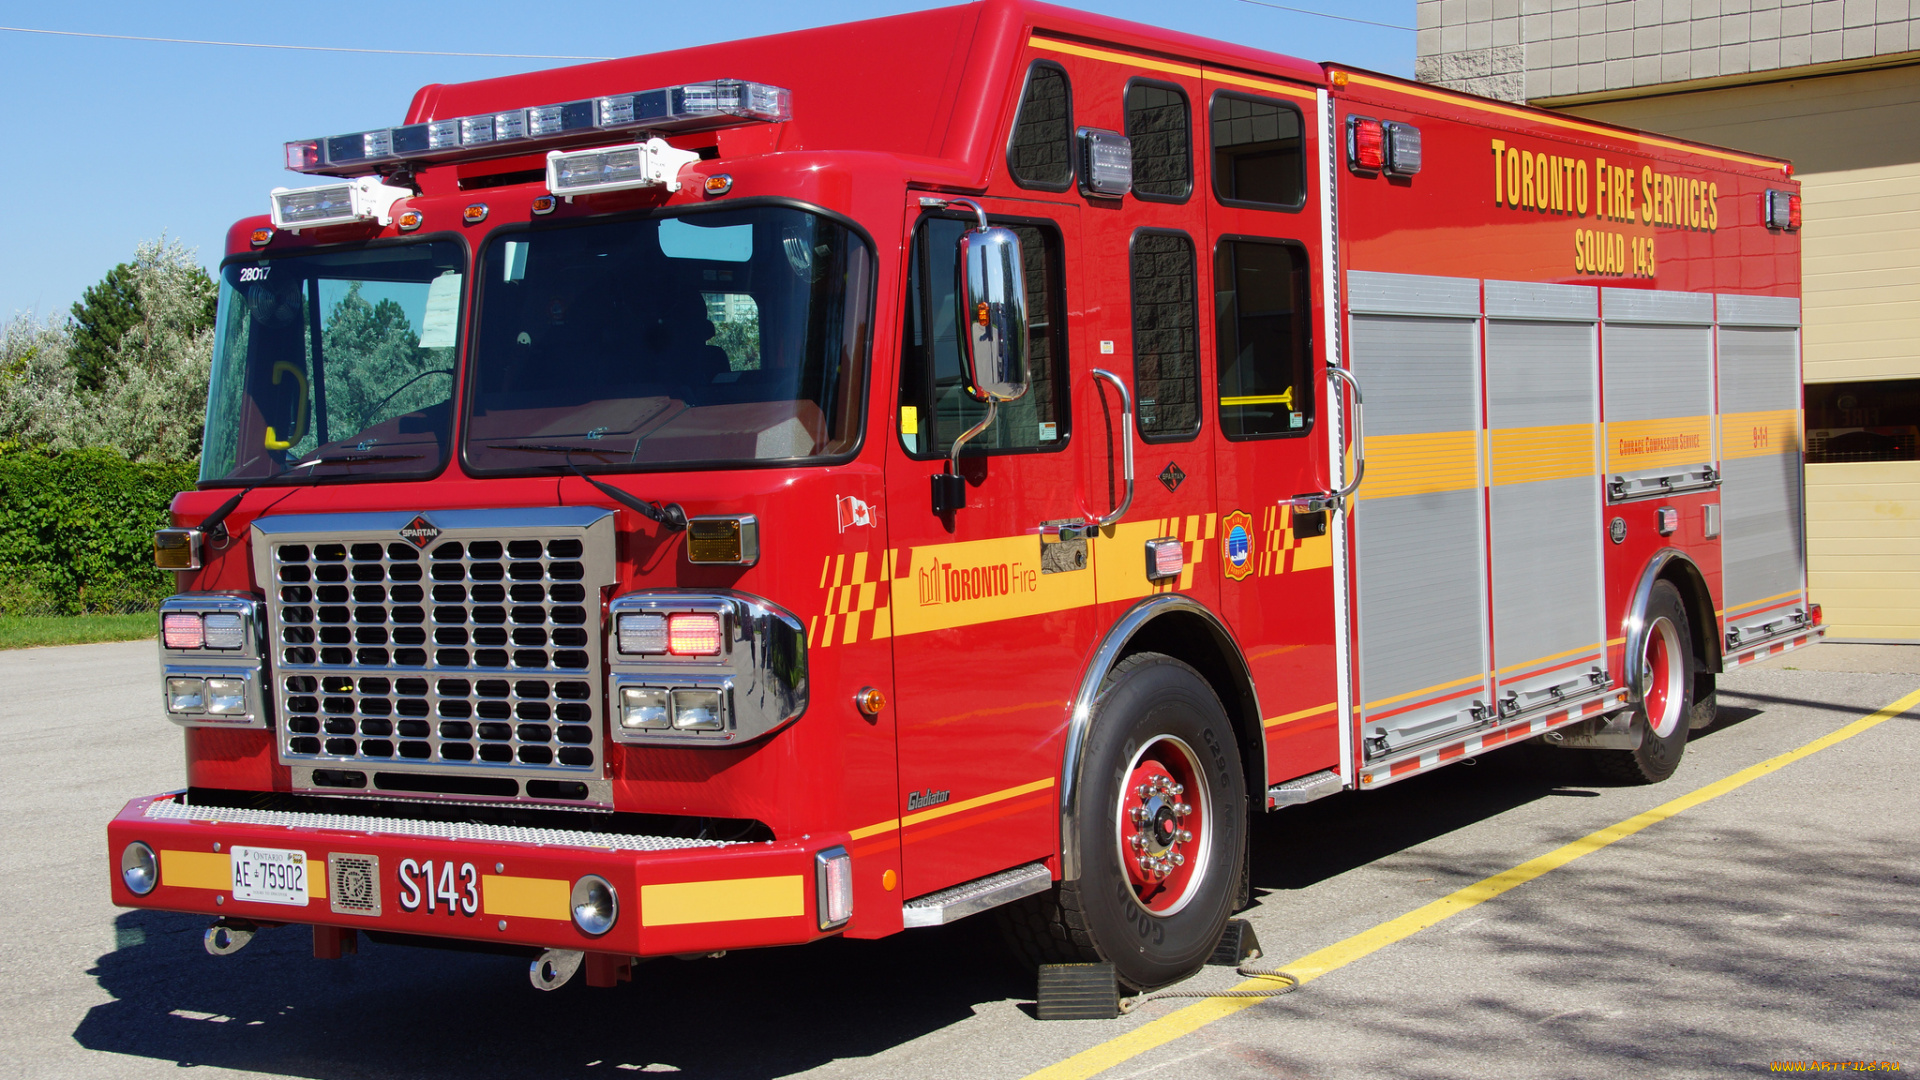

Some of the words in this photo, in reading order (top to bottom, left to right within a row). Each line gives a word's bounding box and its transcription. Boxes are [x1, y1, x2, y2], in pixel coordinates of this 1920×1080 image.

[1492, 138, 1587, 217] TORONTO
[1596, 157, 1635, 223] FIRE
[1641, 165, 1718, 232] SERVICES
[1575, 228, 1625, 276] SQUAD
[1631, 236, 1655, 278] 143
[240, 266, 271, 281] 28017
[1619, 438, 1644, 456] COURAGE
[1646, 436, 1679, 454] COMPASSION
[1680, 433, 1699, 450] SERVICE
[1753, 426, 1768, 448] 9-1-1
[402, 528, 438, 537] SPARTAN
[941, 562, 1009, 603] TORONTO
[1012, 562, 1037, 594] Fire
[907, 788, 950, 811] Gladiator
[253, 851, 283, 861] ONTARIO
[398, 858, 478, 916] S143
